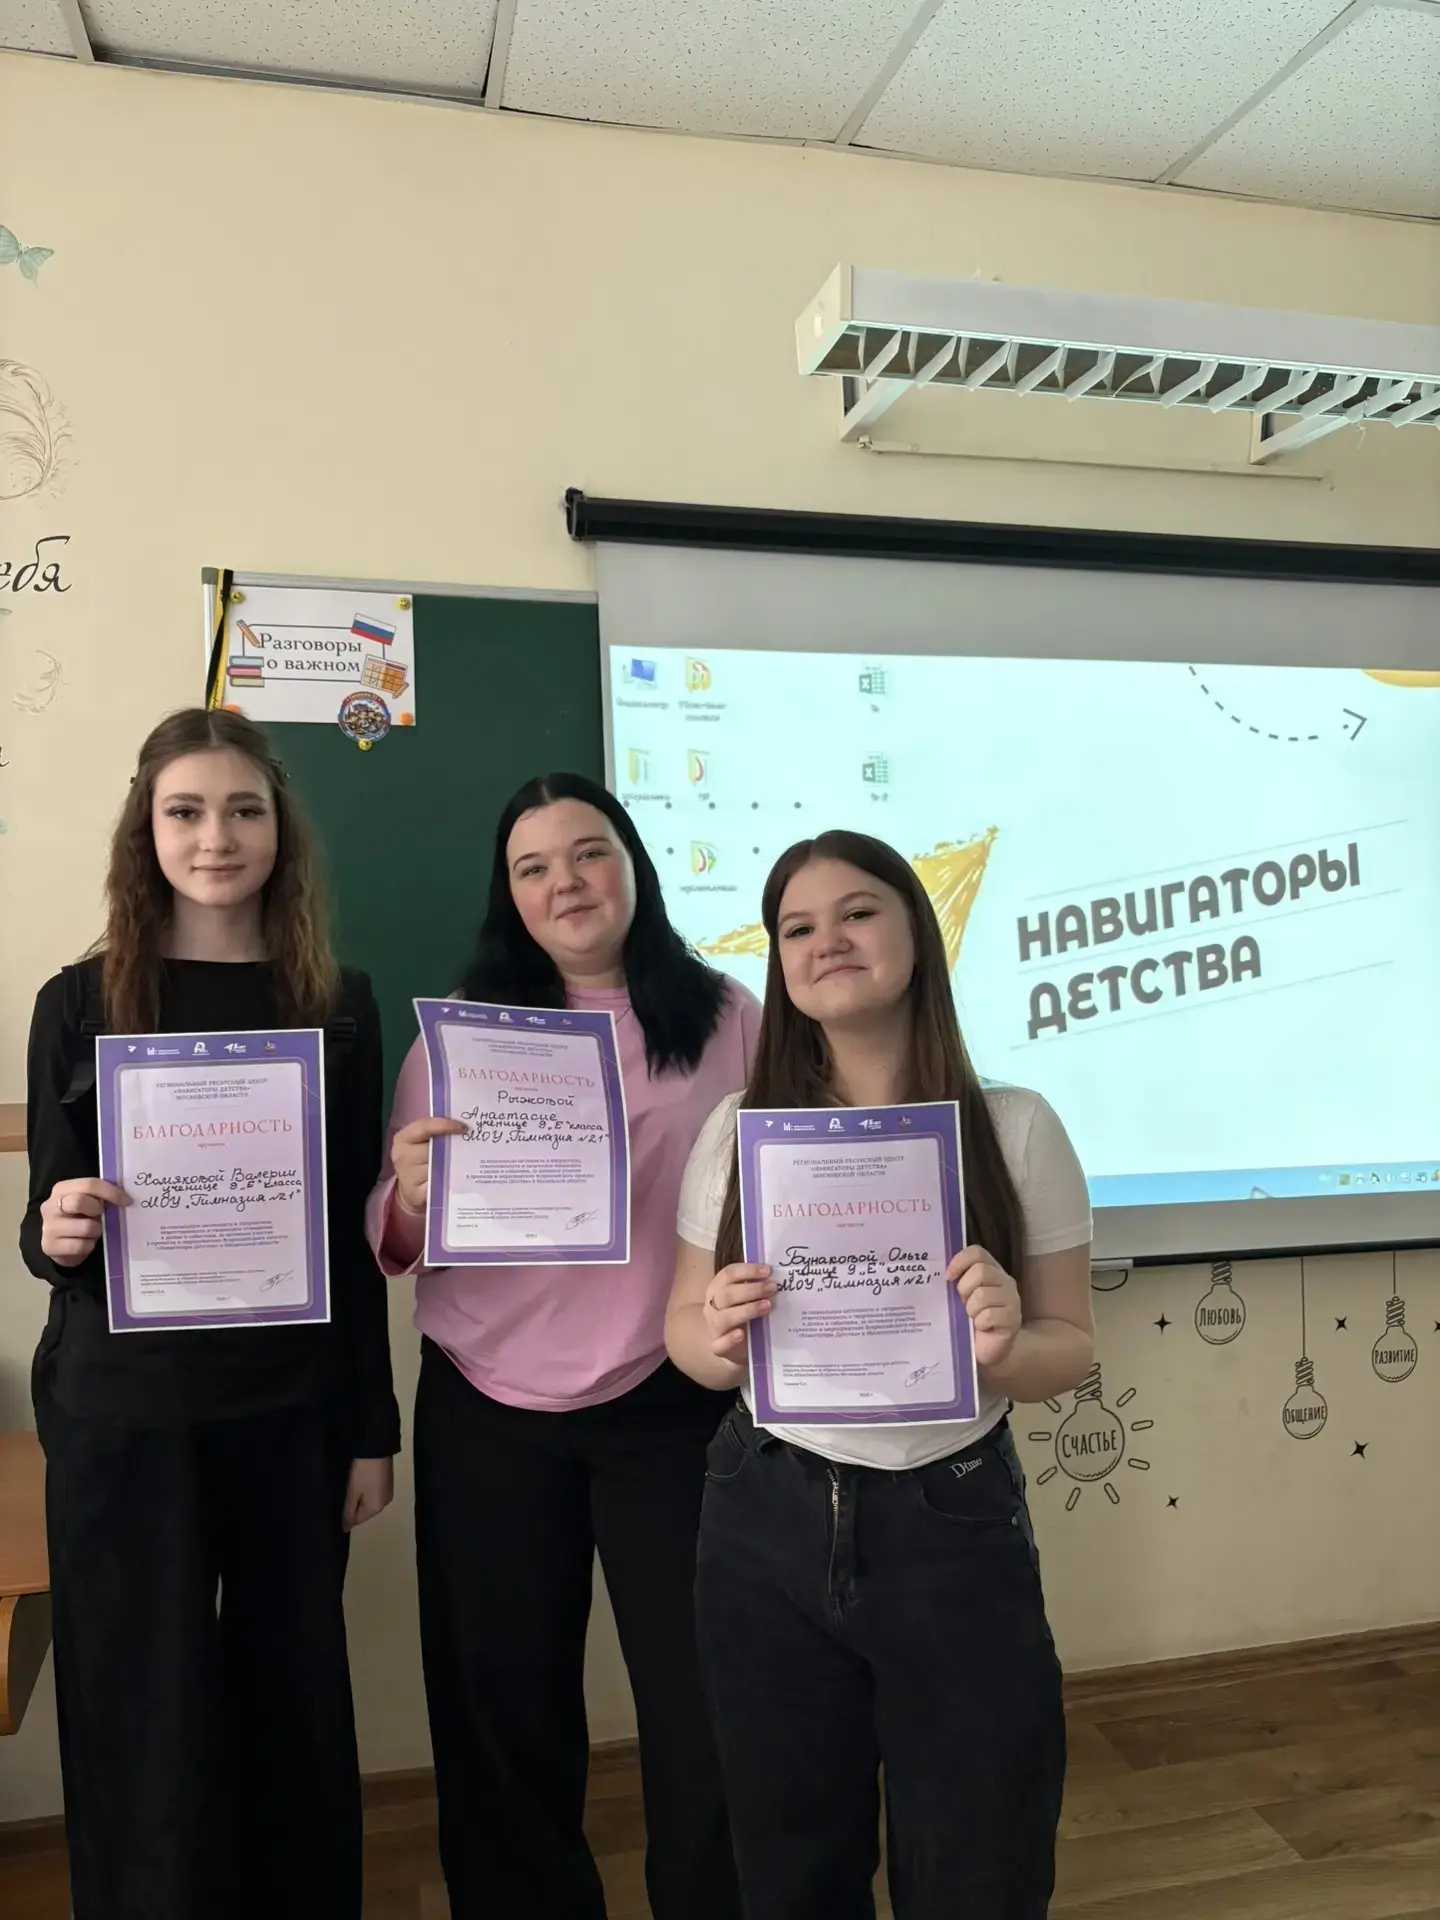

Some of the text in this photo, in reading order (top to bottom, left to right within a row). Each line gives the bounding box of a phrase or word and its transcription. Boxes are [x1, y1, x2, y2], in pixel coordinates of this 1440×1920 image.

[260, 632, 362, 656] Разговоры
[266, 659, 360, 672] о важном
[1016, 842, 1360, 962] НАВИГАТОРЫ
[1027, 935, 1262, 1040] ДЕТСТВА
[459, 1067, 595, 1088] БЛАГОДАРНОСТЬ
[133, 1119, 292, 1139] БЛАГОДАРНОСТЬ
[476, 1121, 528, 1132] ученице
[538, 1121, 546, 1129] 9
[569, 1123, 604, 1131] класса
[462, 1130, 503, 1143] МОУ
[134, 1168, 296, 1187] Хомяковой Валерии
[163, 1182, 218, 1195] ученице
[229, 1182, 238, 1190] 9
[264, 1179, 302, 1188] класса
[141, 1195, 181, 1209] МОУ
[773, 1198, 931, 1218] БЛАГОДАРНОСТЬ
[779, 1246, 929, 1268] Бунаковой Ольге
[848, 1265, 856, 1275] 9
[777, 1277, 814, 1291] МОУ
[1199, 1308, 1242, 1326] ЛЮБОВЬ
[1375, 1349, 1415, 1365] РАЗВИТИЕ
[1285, 1406, 1326, 1424] ОБЩЕНИЕ
[1062, 1430, 1117, 1458] СЧАСТЬЕ
